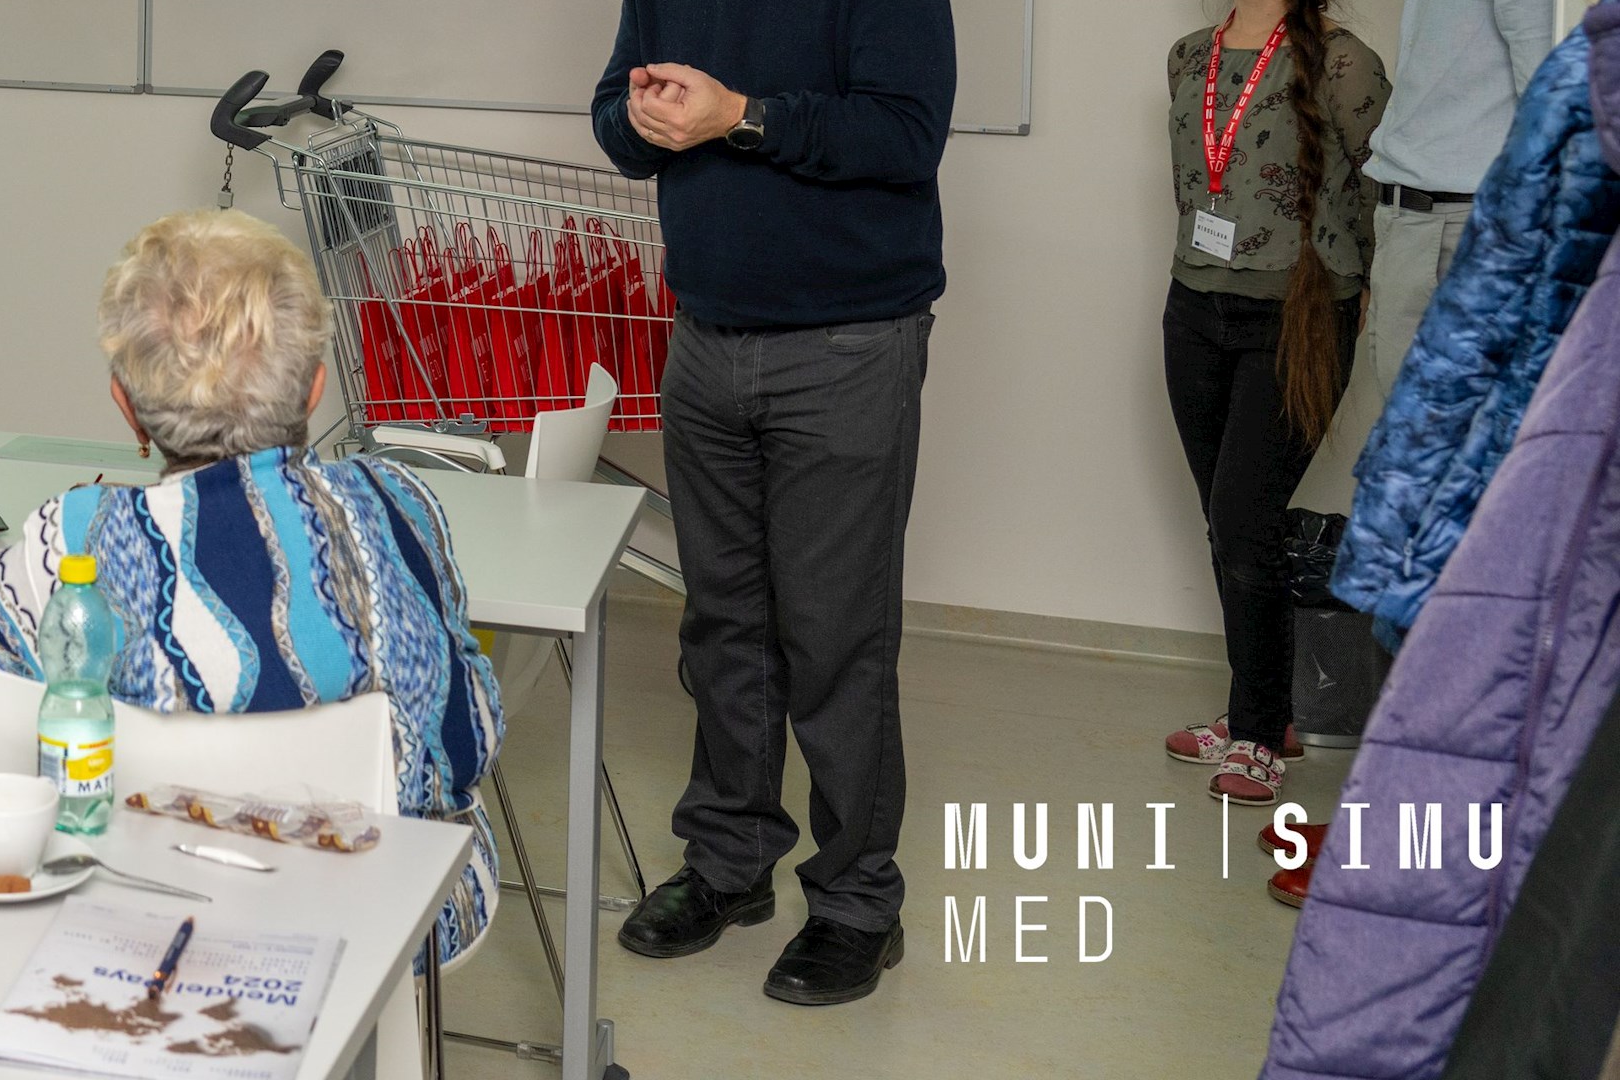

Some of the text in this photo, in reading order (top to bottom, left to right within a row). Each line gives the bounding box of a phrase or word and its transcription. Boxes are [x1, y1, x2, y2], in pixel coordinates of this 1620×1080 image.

[1208, 43, 1220, 80] MED
[1249, 45, 1275, 82] MED
[1205, 82, 1215, 133] MUNI
[1227, 82, 1255, 134] MUNI
[1214, 133, 1233, 173] MED
[176, 983, 298, 1007] Mendel
[223, 975, 304, 993] 2024
